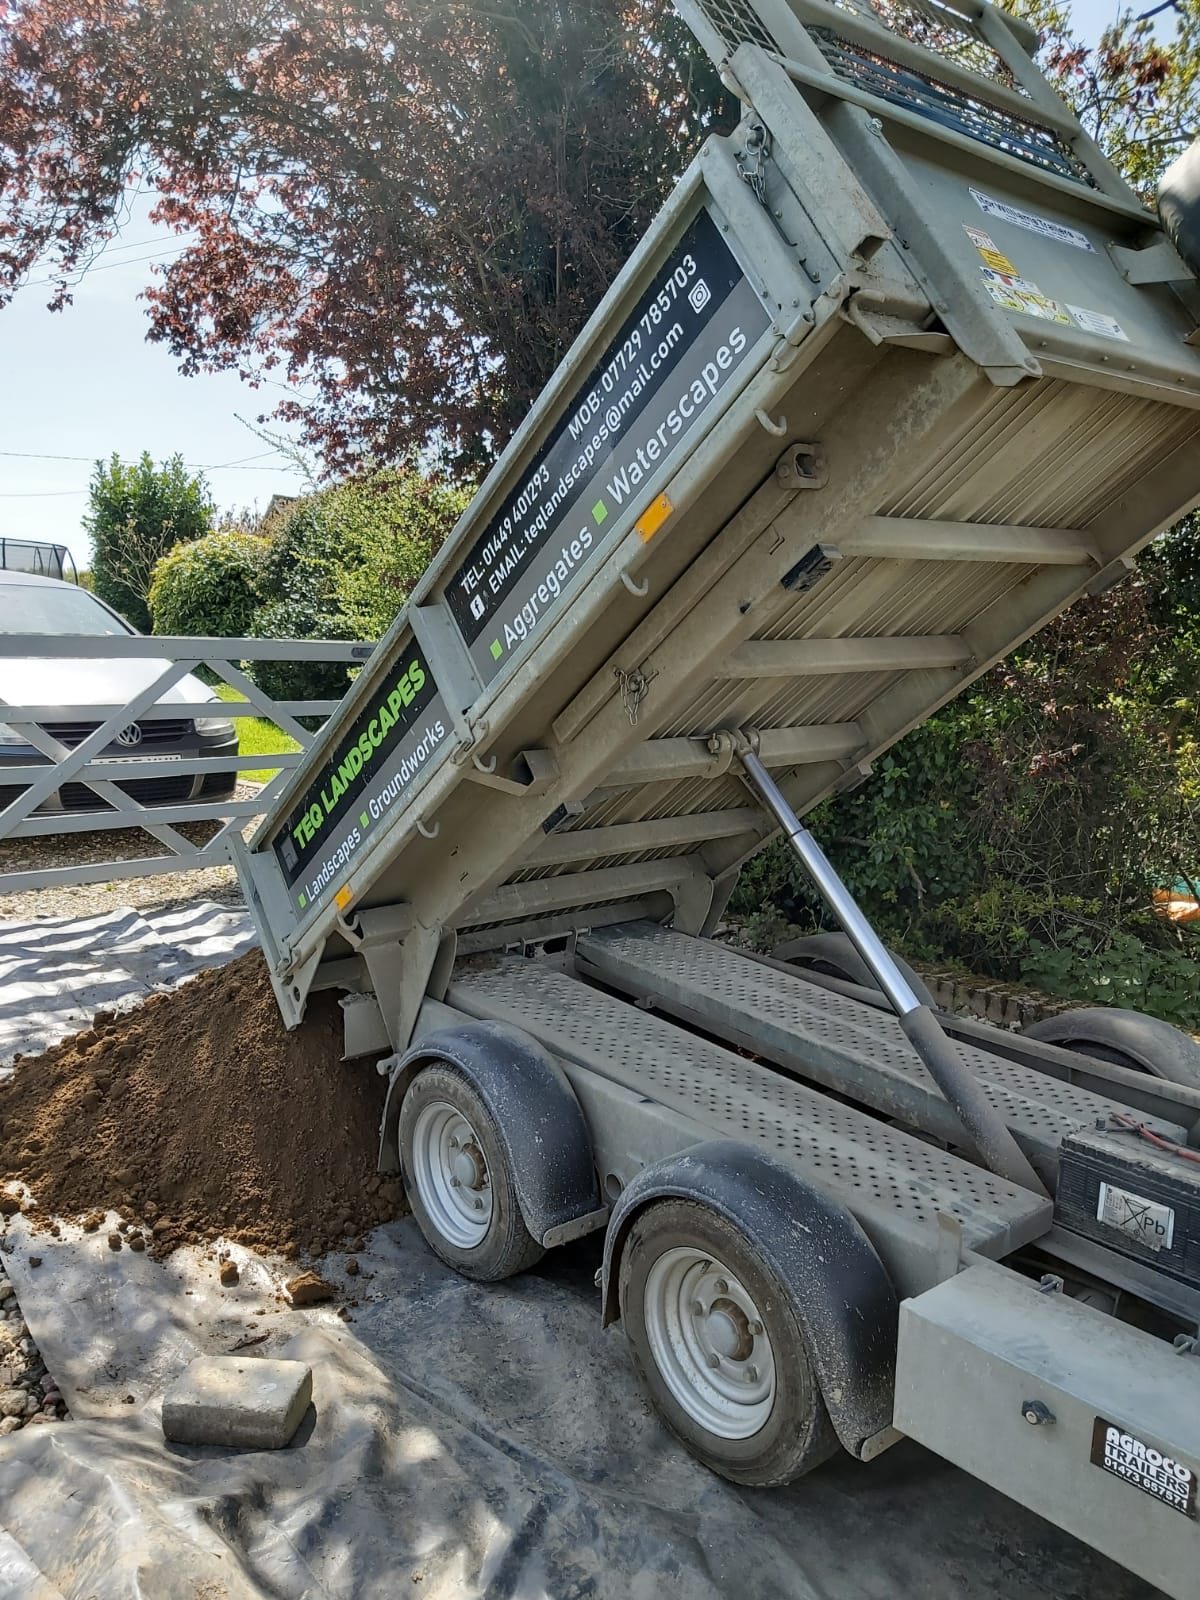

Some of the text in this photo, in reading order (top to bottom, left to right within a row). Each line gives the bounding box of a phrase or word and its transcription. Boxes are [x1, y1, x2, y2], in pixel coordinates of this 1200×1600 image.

[460, 254, 697, 595] TEL: 01449 401293 MOB: 07729 785703
[488, 322, 684, 594] EMAIL: teqlandscapes@mail.com
[503, 326, 746, 650] Aggregates Waterscapes
[293, 660, 426, 850] TEQ LANDSCAPES
[305, 719, 445, 902] Landscapes Groundworks
[1144, 1217, 1166, 1236] Pb
[1104, 1457, 1140, 1482] 01473
[1143, 1478, 1188, 1509] 657571
[1106, 1427, 1191, 1482] AGROCO
[1106, 1442, 1188, 1496] TRAILERS
